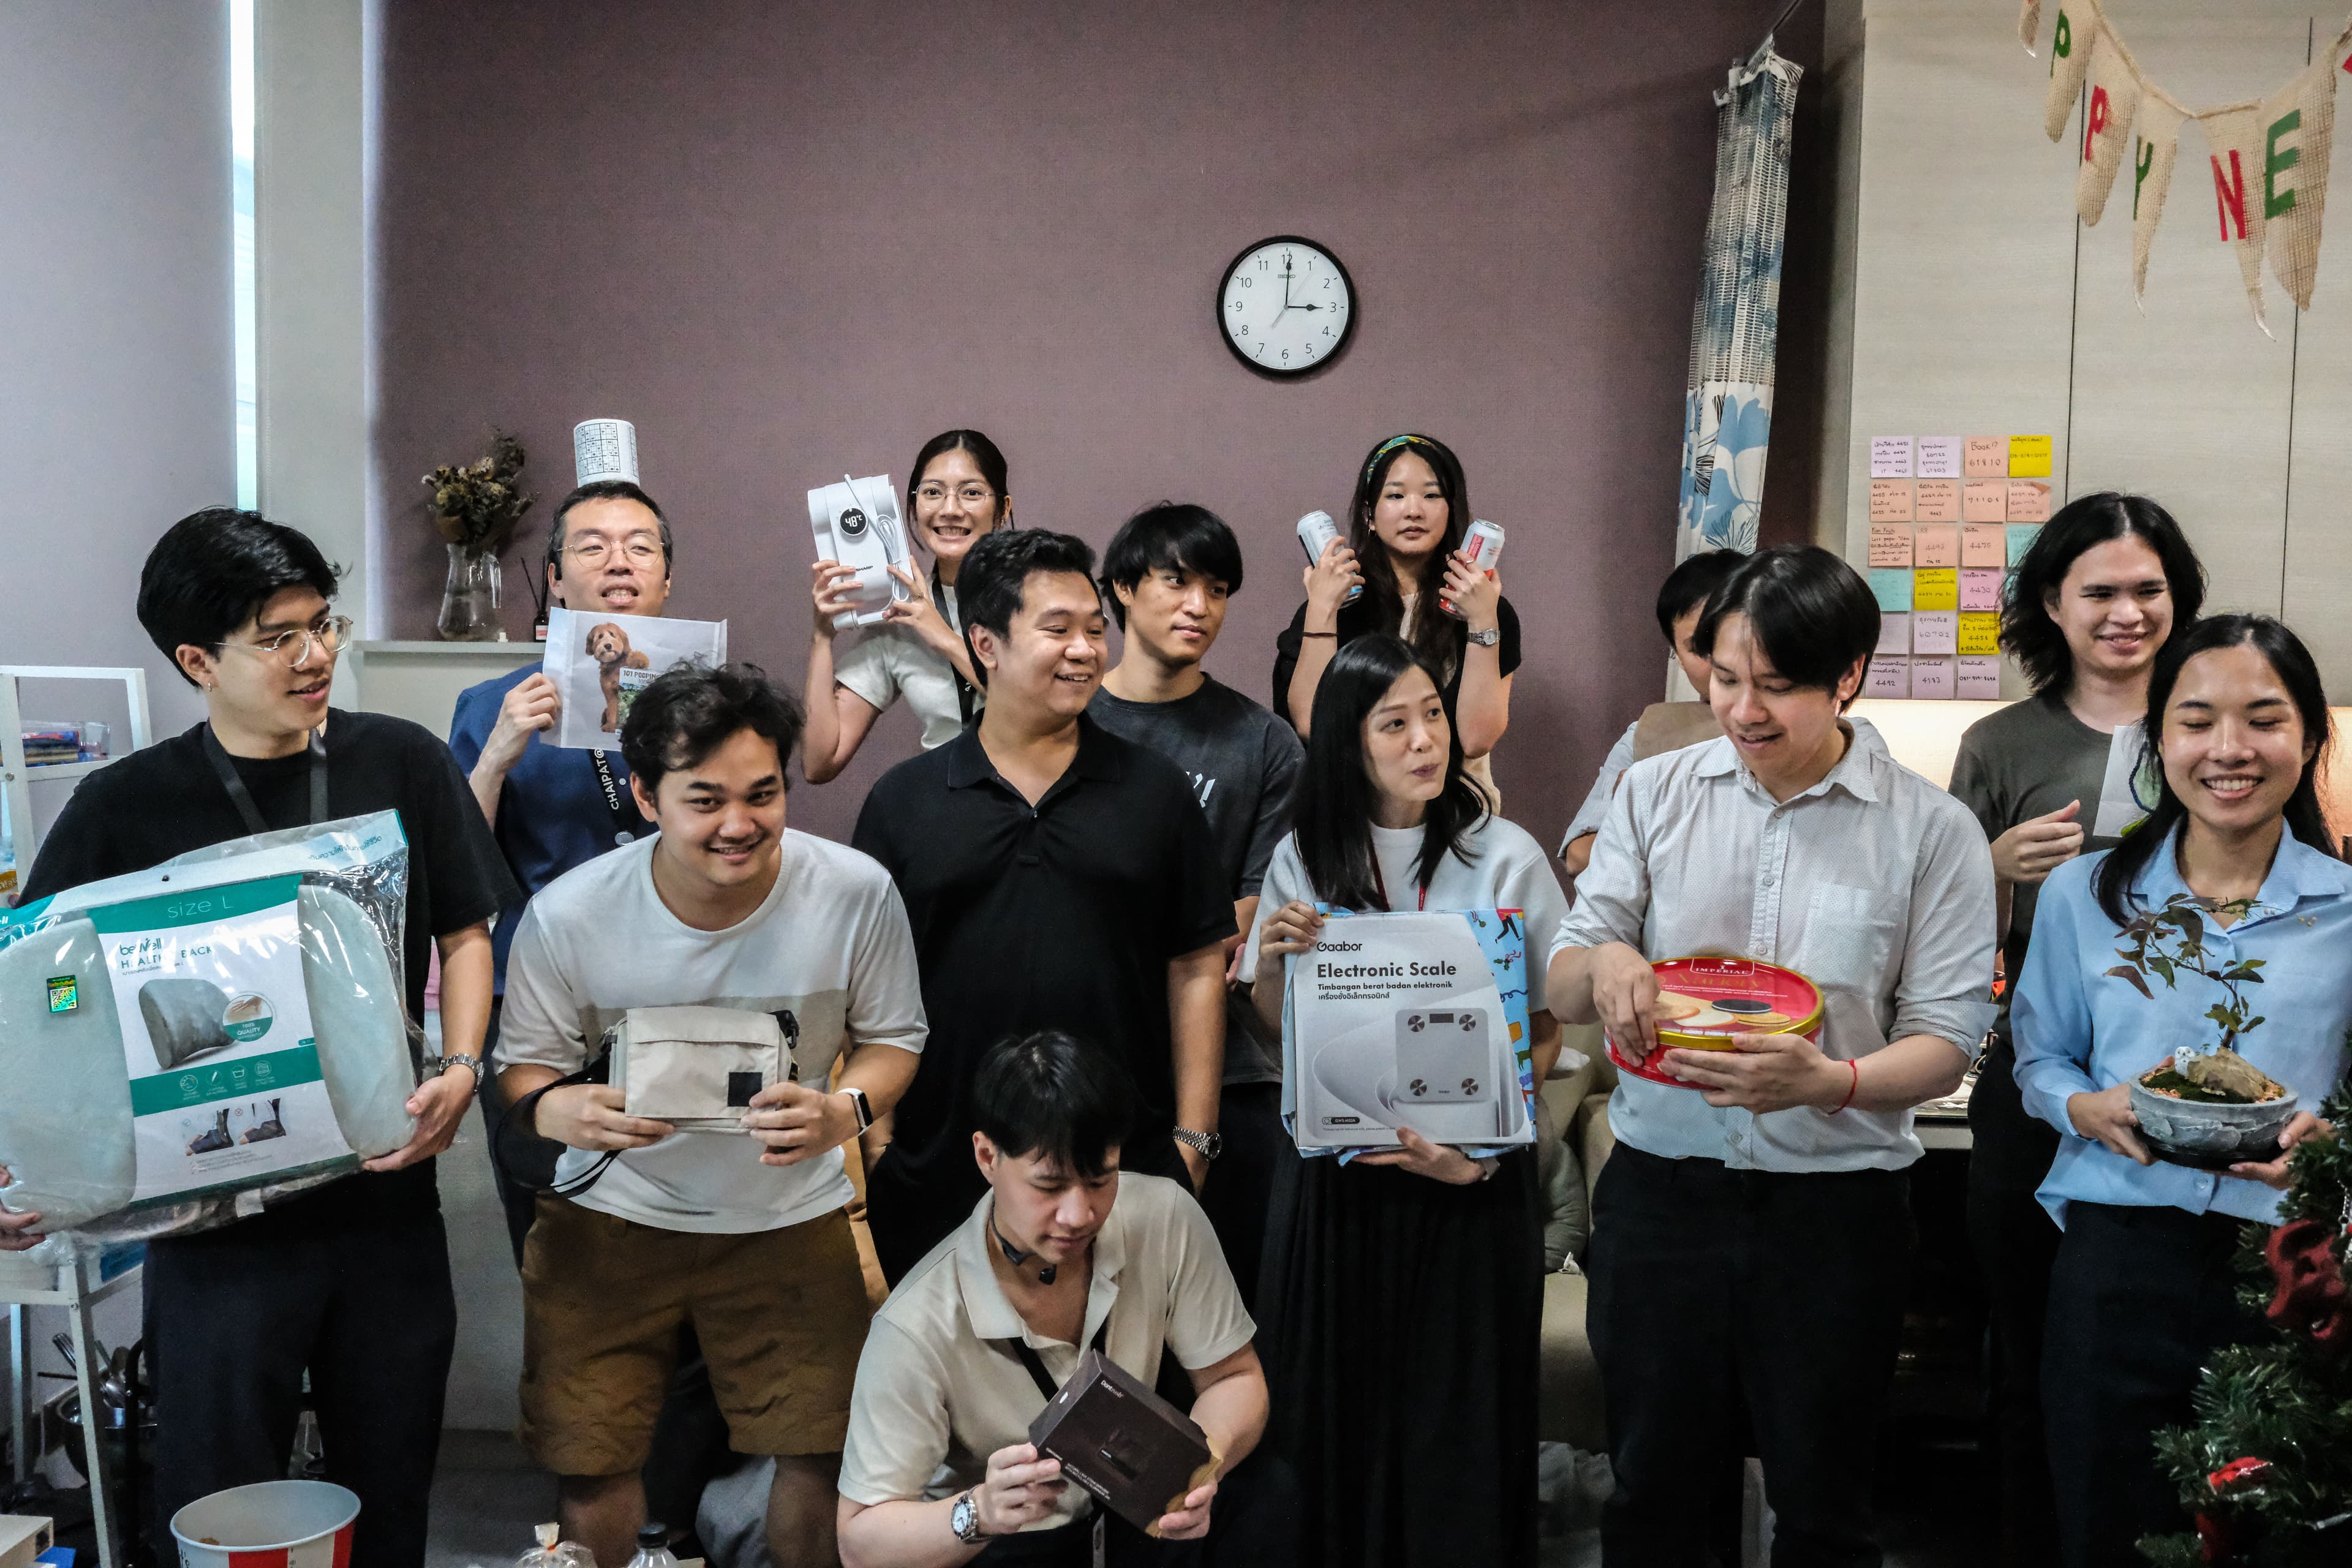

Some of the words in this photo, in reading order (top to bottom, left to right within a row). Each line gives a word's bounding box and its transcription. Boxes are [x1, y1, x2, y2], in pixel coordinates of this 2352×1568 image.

[1281, 254, 1292, 265] 12
[1258, 260, 1268, 271] 11
[1308, 261, 1312, 271] 1
[1241, 277, 1252, 288] 10
[1323, 278, 1330, 288] 2
[1235, 301, 1243, 311] 9
[1330, 302, 1336, 312] 3
[1242, 325, 1248, 335] 8
[1322, 326, 1329, 336] 4
[1258, 343, 1264, 353] 7
[1306, 343, 1312, 353] 5
[1281, 349, 1289, 360] 6
[634, 671, 657, 680] POOPIN
[167, 902, 211, 918] size
[222, 894, 233, 909] L
[1316, 941, 1363, 952] Gaabor
[1317, 962, 1404, 978] Electronic
[1409, 960, 1457, 976] Scale
[1317, 983, 1361, 992] Timbangan
[1318, 991, 1390, 1000] เครื่องชั่งอิเล็กทรอนิกส์
[236, 1027, 260, 1036] QUALITY
